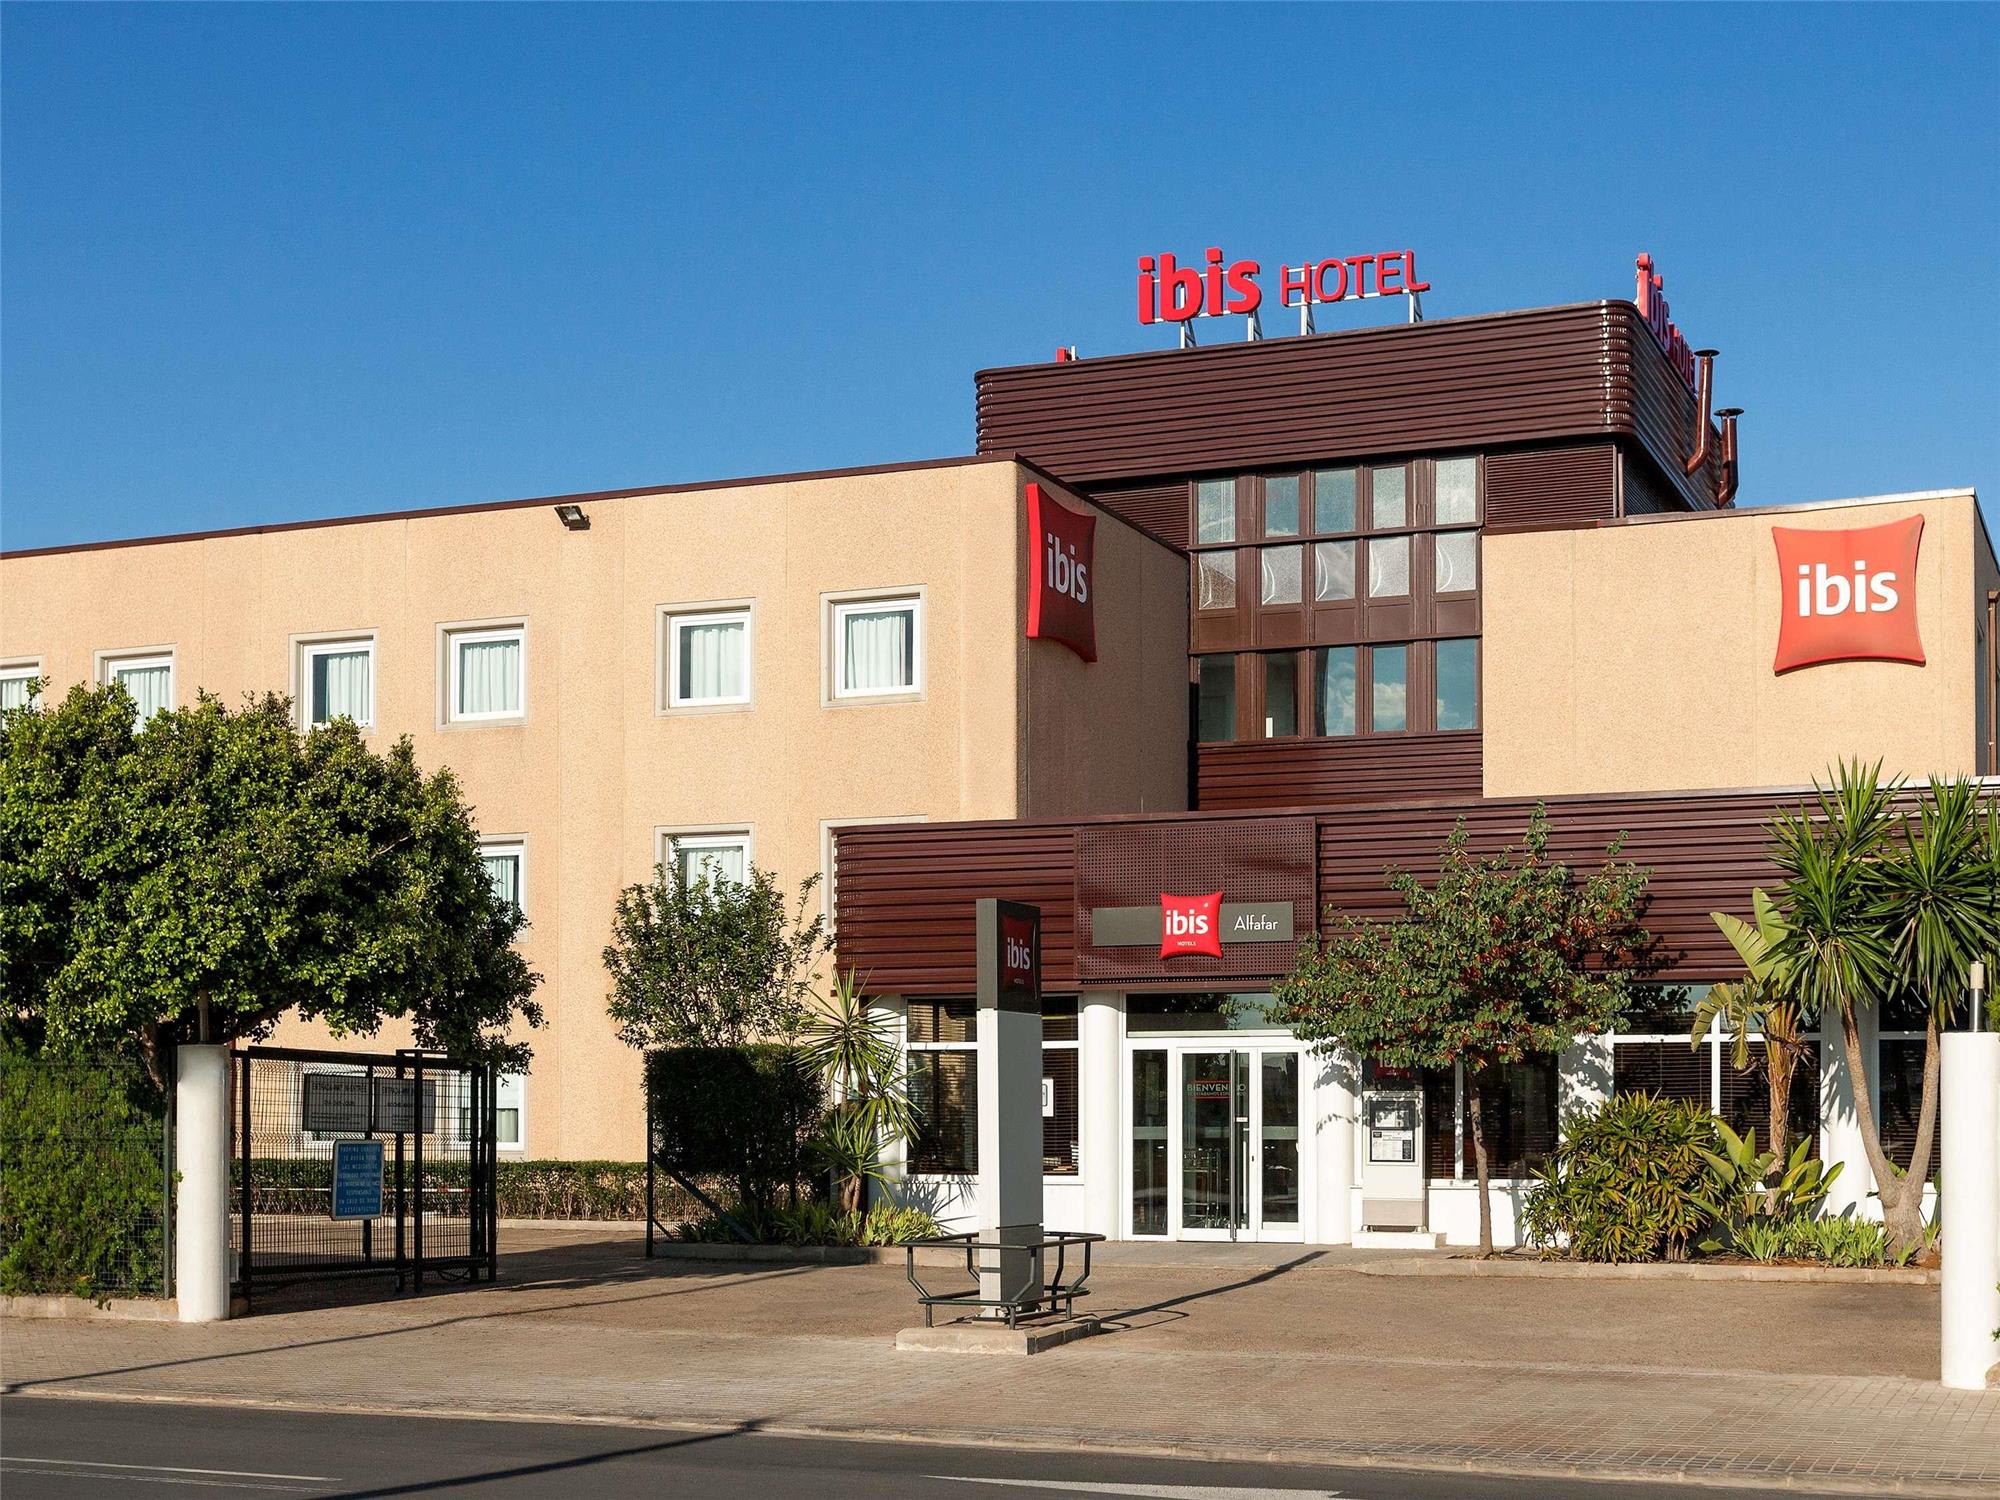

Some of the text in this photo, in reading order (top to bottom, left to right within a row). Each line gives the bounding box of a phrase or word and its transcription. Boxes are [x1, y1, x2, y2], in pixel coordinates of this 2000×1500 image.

[1138, 247, 1430, 325] ibis HOTEL
[1047, 532, 1088, 604] ibis
[1798, 560, 1899, 617] ibis
[1166, 909, 1209, 935] ibis
[1234, 914, 1279, 931] Alfafar
[1007, 936, 1031, 970] ibis
